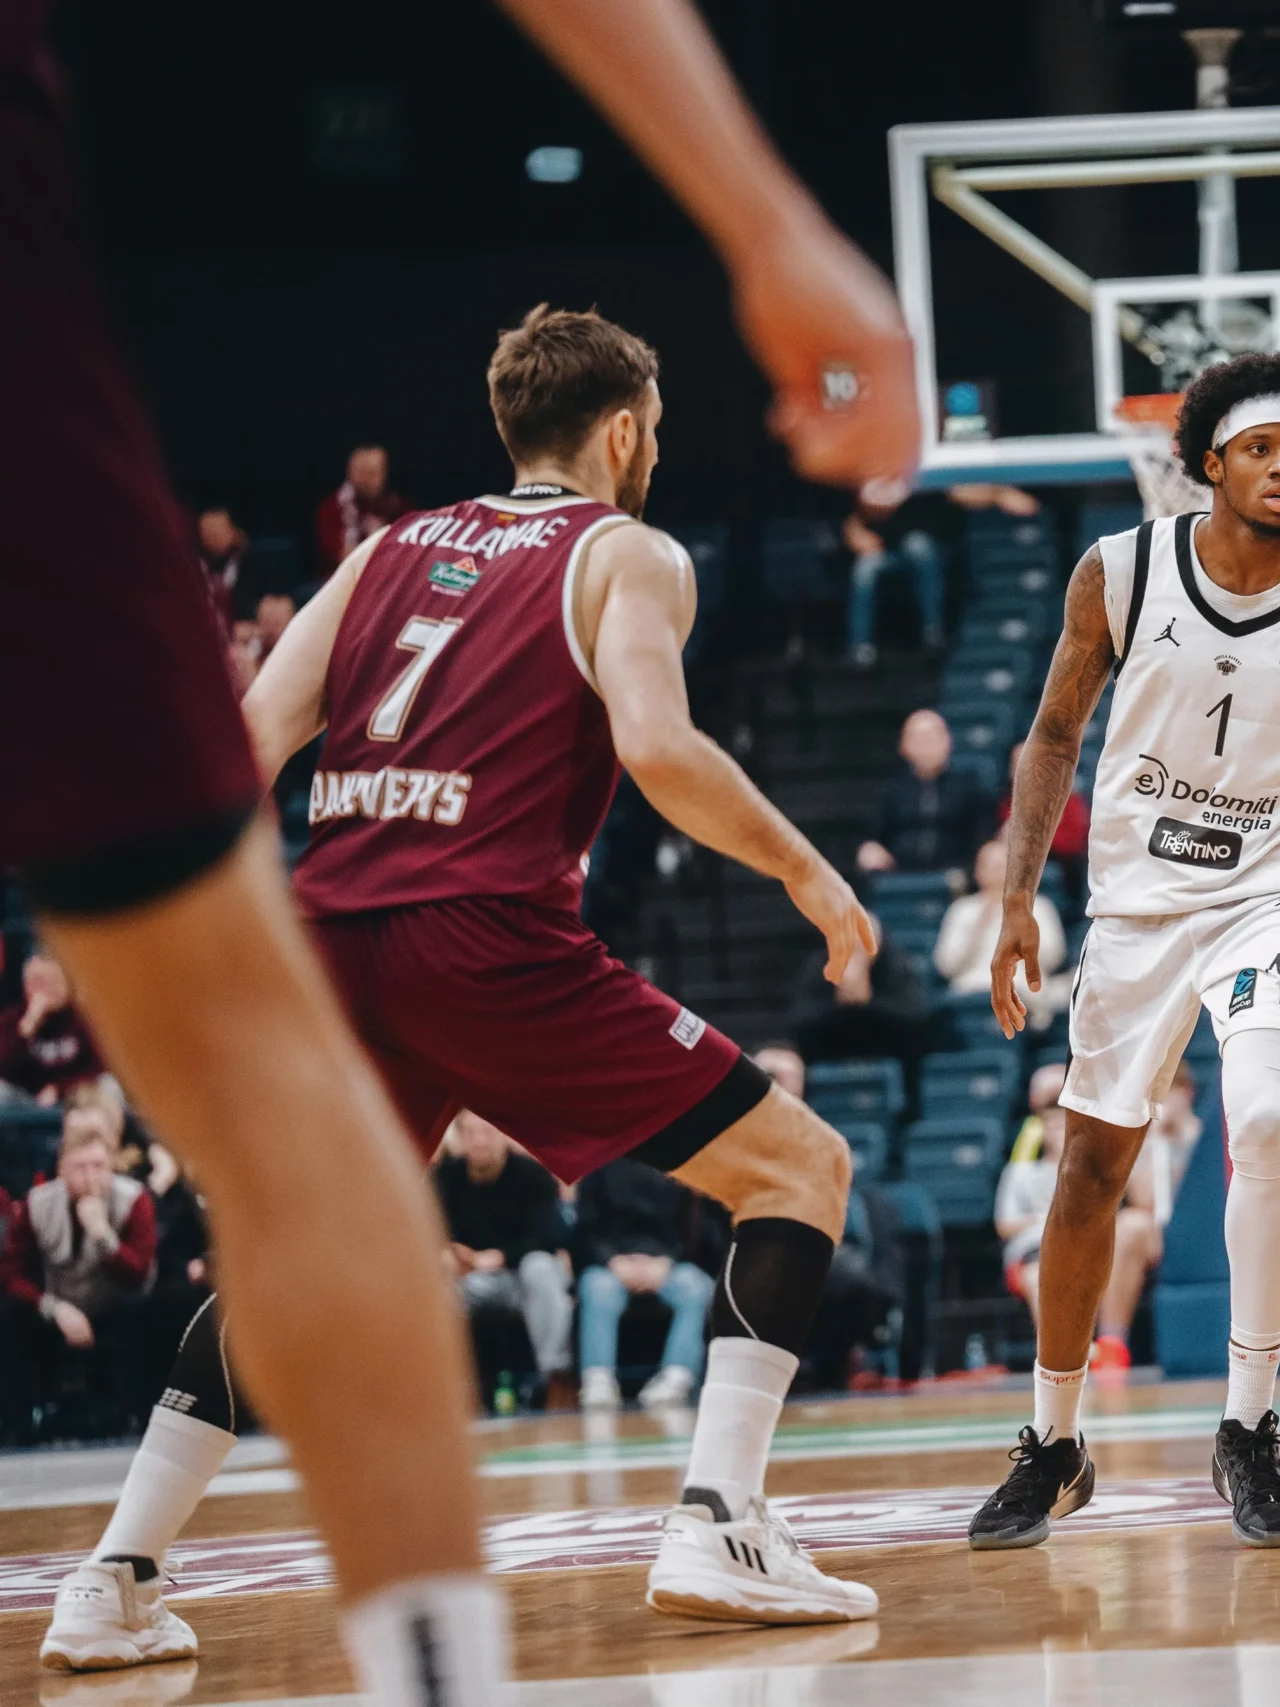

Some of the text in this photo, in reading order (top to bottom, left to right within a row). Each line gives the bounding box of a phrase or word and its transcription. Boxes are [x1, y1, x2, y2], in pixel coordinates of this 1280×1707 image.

[367, 615, 464, 741] 7
[1206, 693, 1233, 757] 1
[1159, 829, 1232, 862] TRENTINO
[1202, 811, 1272, 834] energia
